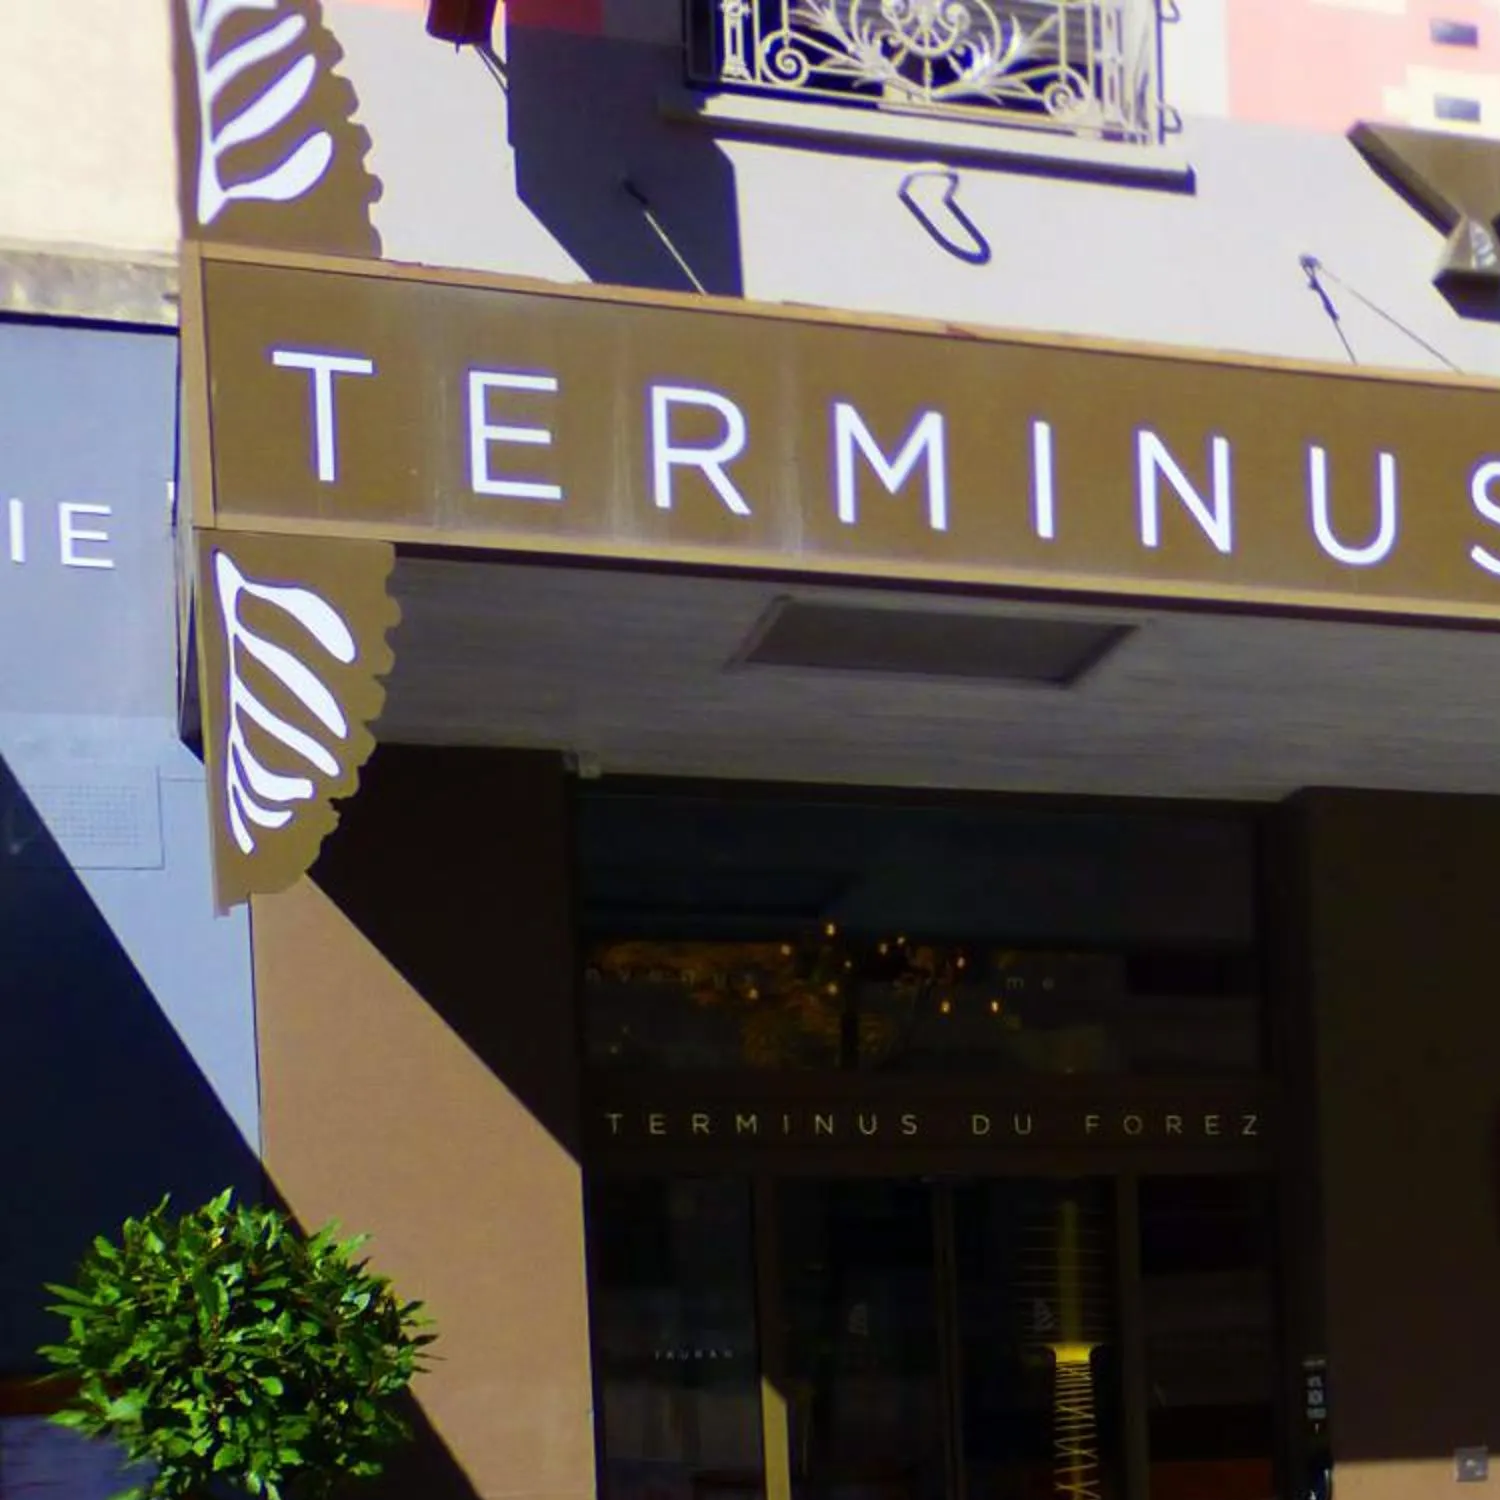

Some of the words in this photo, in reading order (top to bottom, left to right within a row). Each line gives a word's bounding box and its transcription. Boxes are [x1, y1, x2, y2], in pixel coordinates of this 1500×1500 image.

[9, 498, 115, 569] IE
[606, 1113, 918, 1135] TERMINUS
[971, 1114, 1032, 1135] DU
[1085, 1114, 1258, 1135] FOREZ
